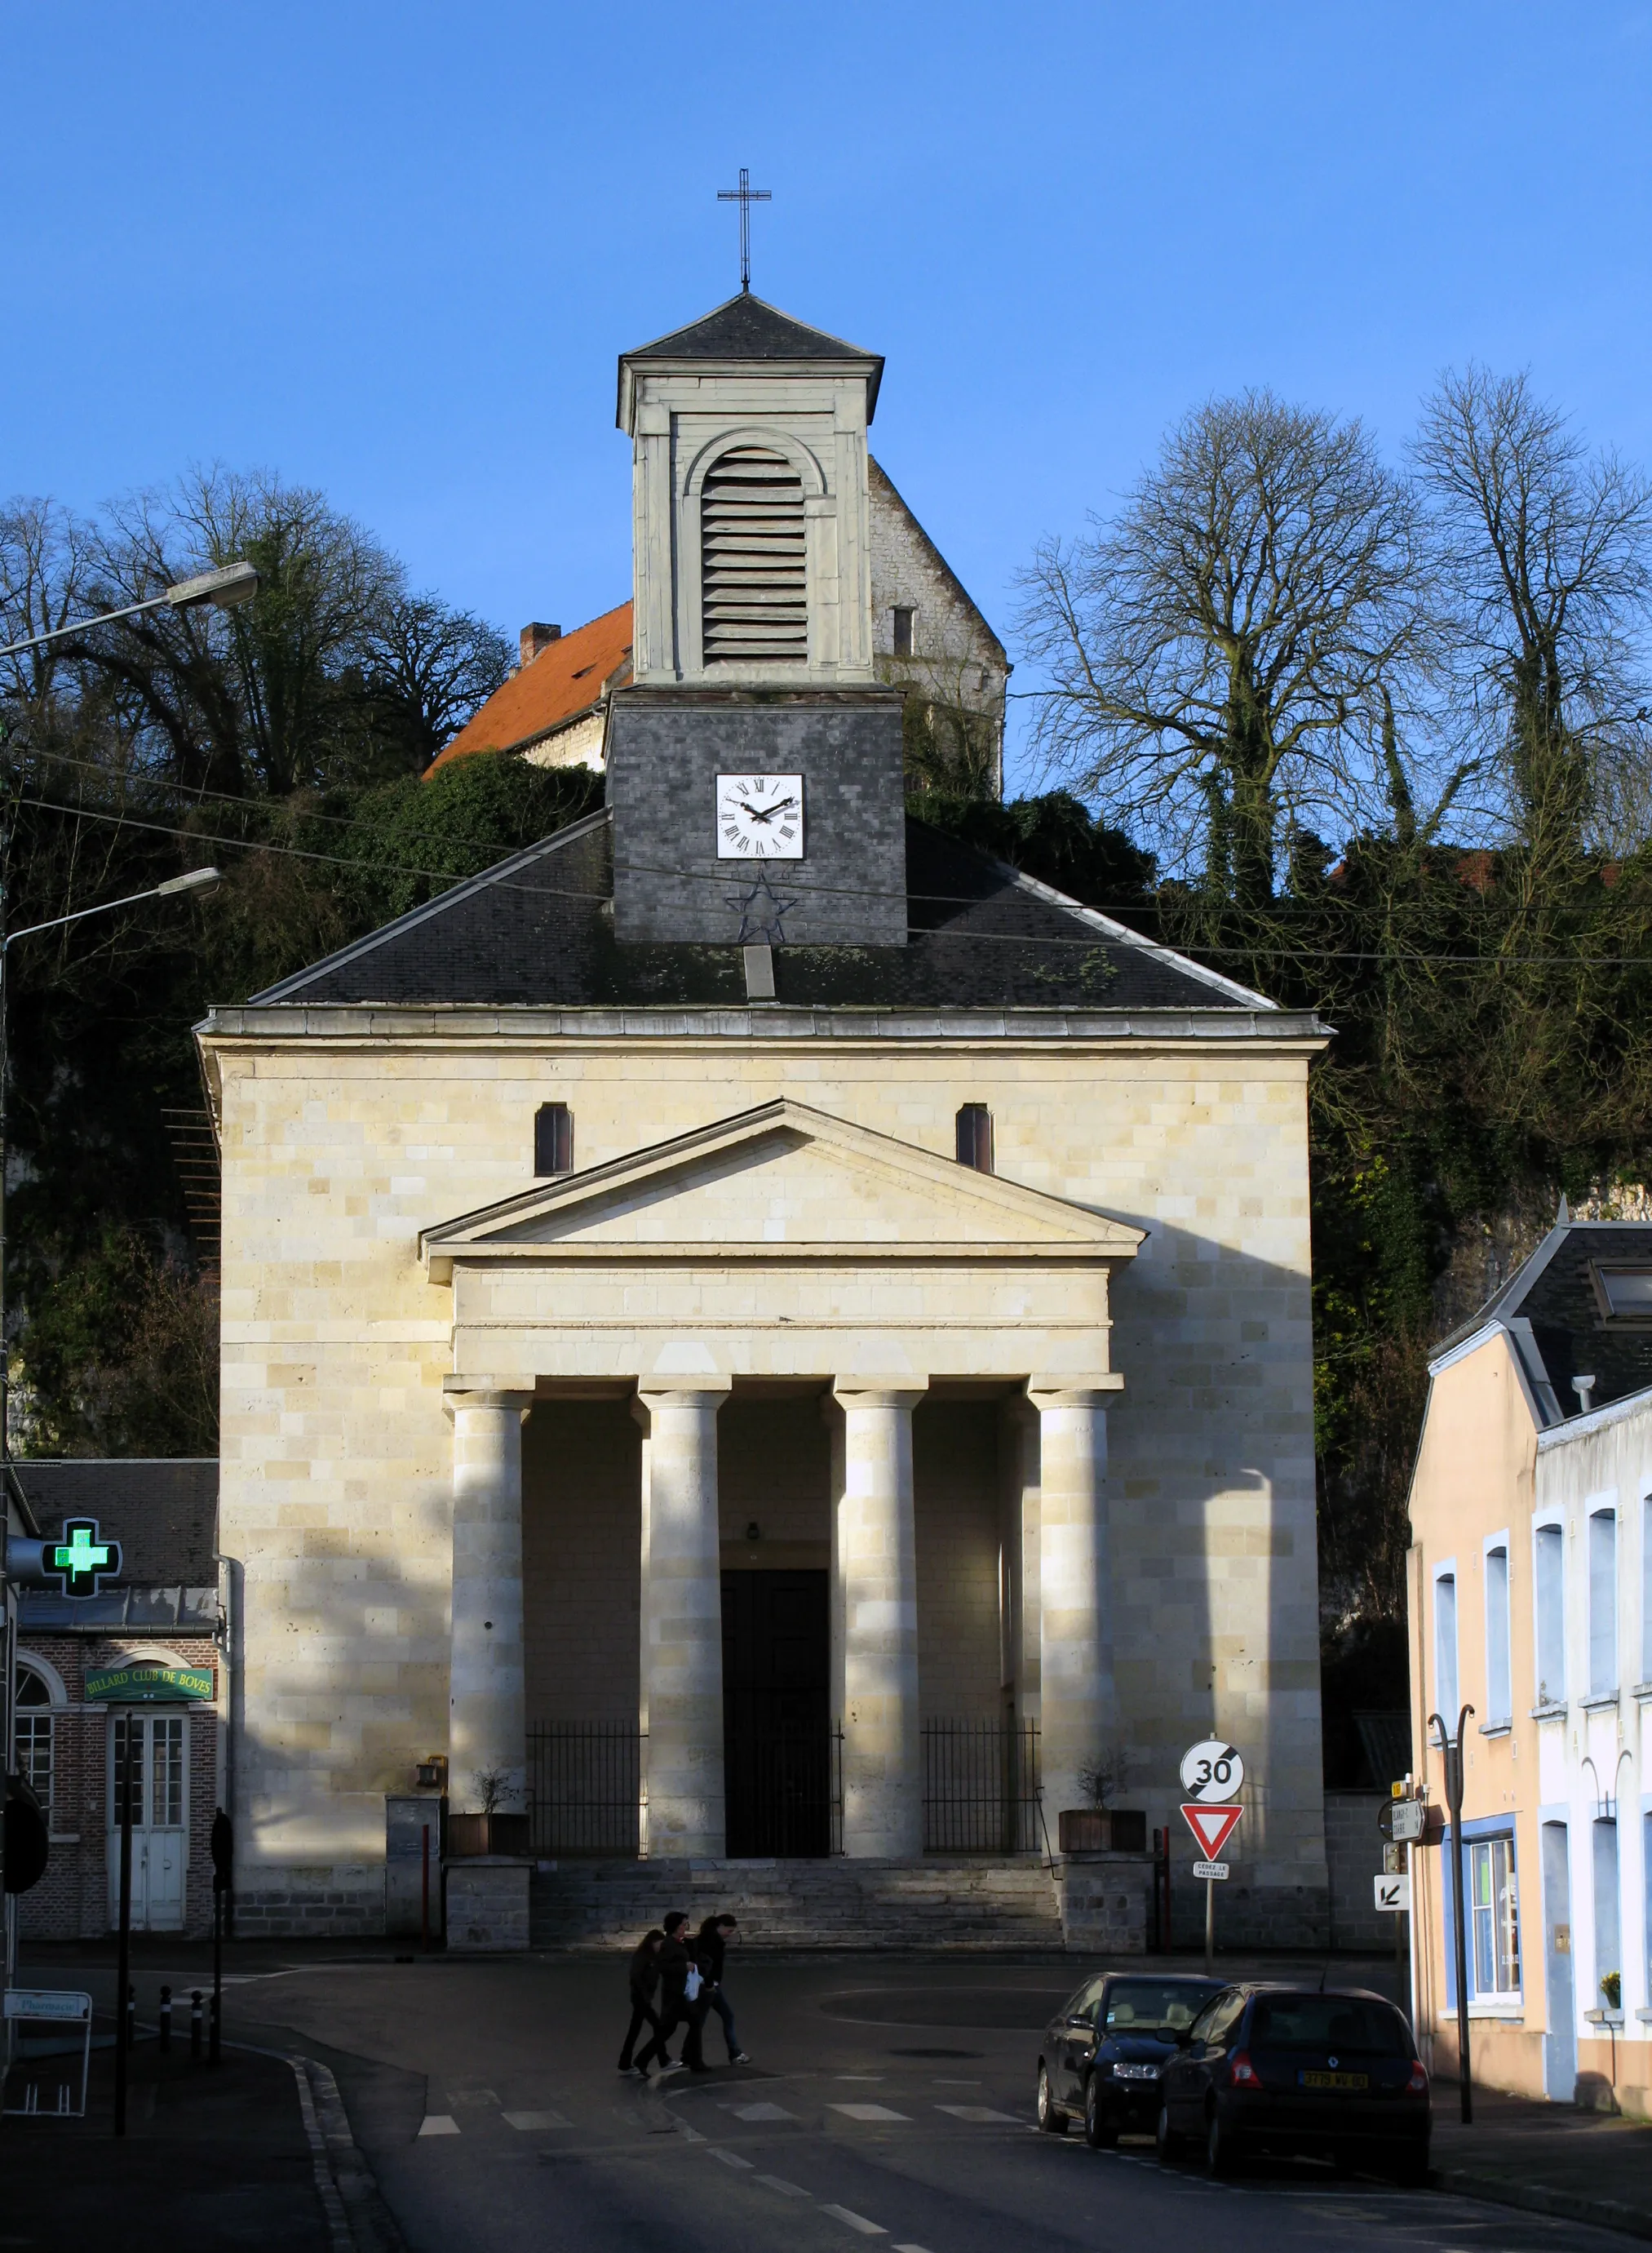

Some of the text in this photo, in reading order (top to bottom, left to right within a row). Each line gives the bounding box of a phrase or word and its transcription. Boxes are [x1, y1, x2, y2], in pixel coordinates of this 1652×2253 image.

[737, 783, 750, 796] XI
[754, 778, 764, 792] XII
[724, 825, 741, 841] VIII
[737, 836, 750, 851] VII
[755, 840, 764, 854] VI
[772, 837, 782, 850] V
[86, 1670, 211, 1695] BILLARD CLUB DE BOVES
[1196, 1759, 1232, 1785] 30
[1305, 2072, 1331, 2086] 3779
